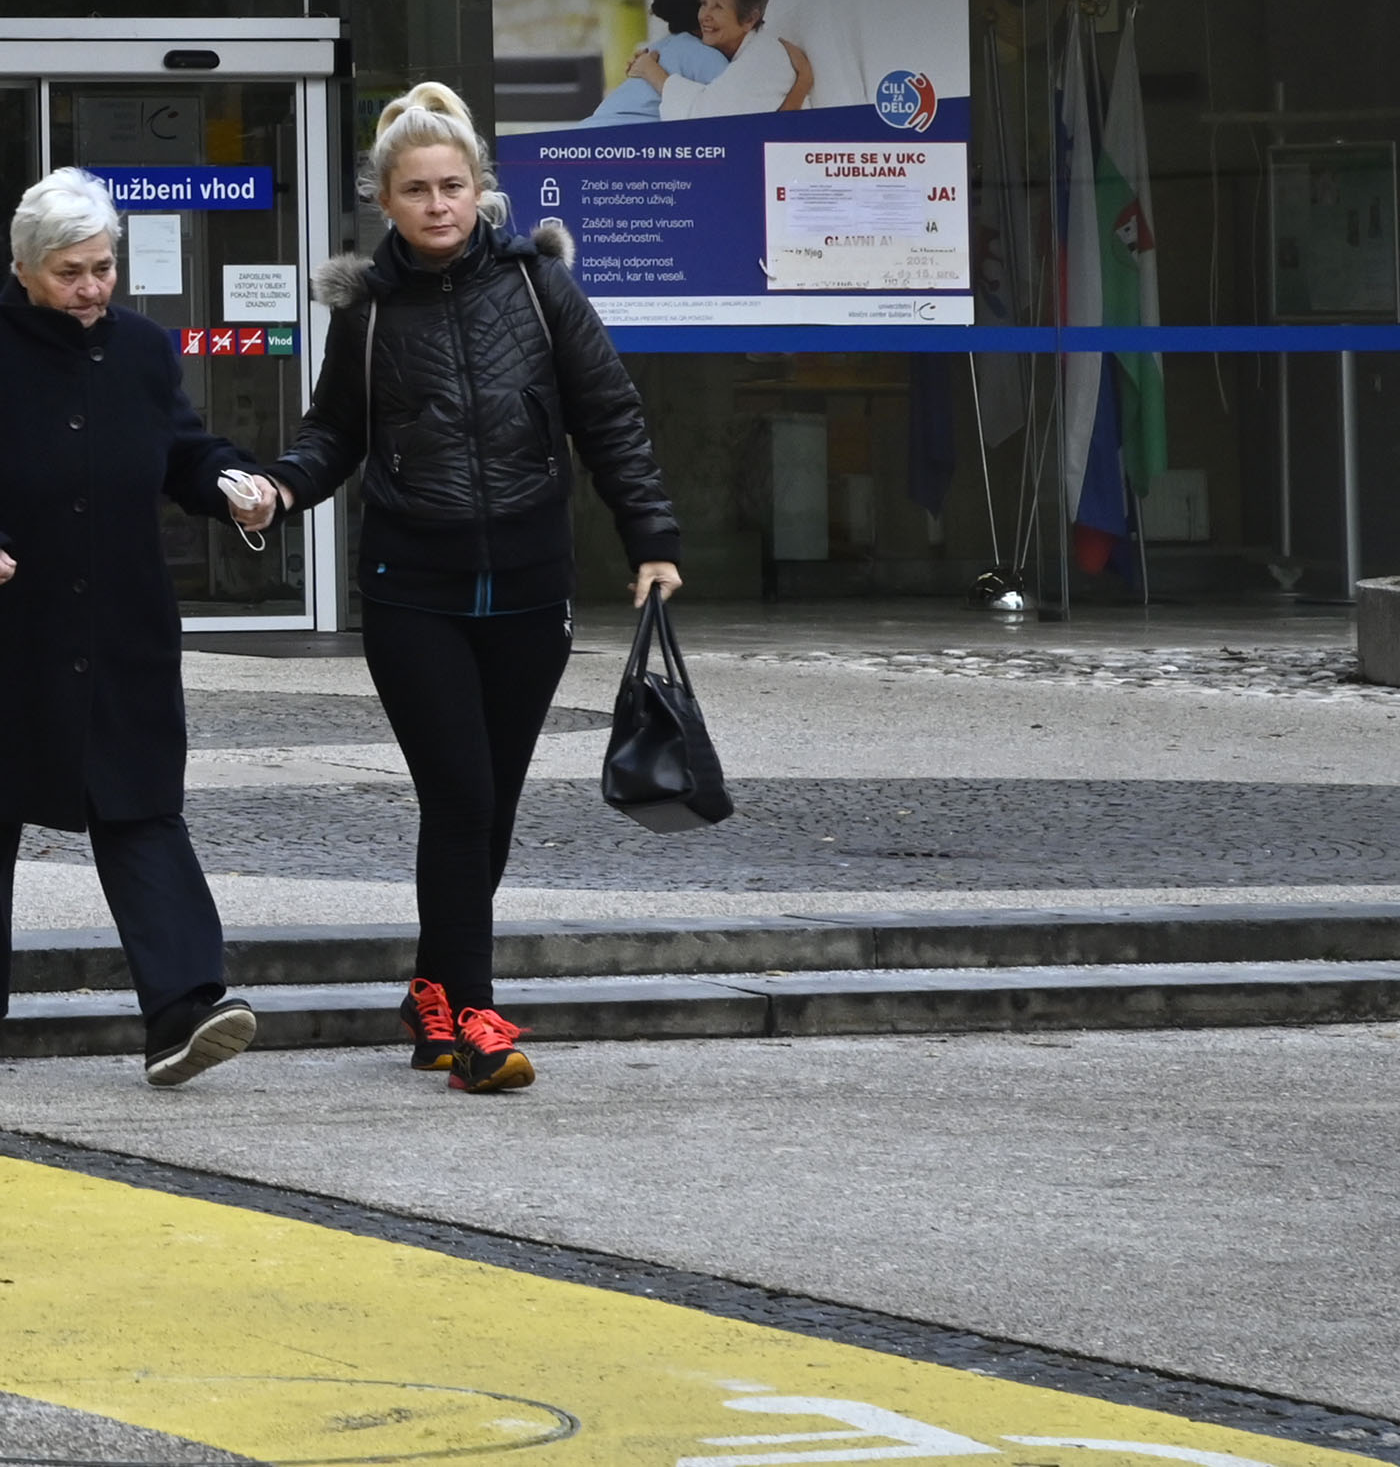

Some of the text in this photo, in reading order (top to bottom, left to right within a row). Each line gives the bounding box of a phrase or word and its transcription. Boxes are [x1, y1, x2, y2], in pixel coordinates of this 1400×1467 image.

[881, 81, 905, 94] ČILI
[881, 102, 915, 113] DELO
[540, 147, 726, 159] POHODI COVID-19 IN SE CEPI
[804, 153, 926, 164] CEPITE SE V UKC
[825, 166, 907, 178] LJUBLJANA
[107, 177, 255, 200] lužbeni vhod
[581, 179, 692, 192] Znebi se vseh omejitev
[582, 195, 591, 205] in
[593, 194, 644, 207] sproščeno
[581, 217, 694, 231] Zaščiti se pred virusom
[582, 233, 591, 243] in
[582, 256, 673, 270] Izboljšaj odpornost
[582, 271, 687, 284] in počni, kar te veseli.
[268, 336, 293, 345] Vhod
